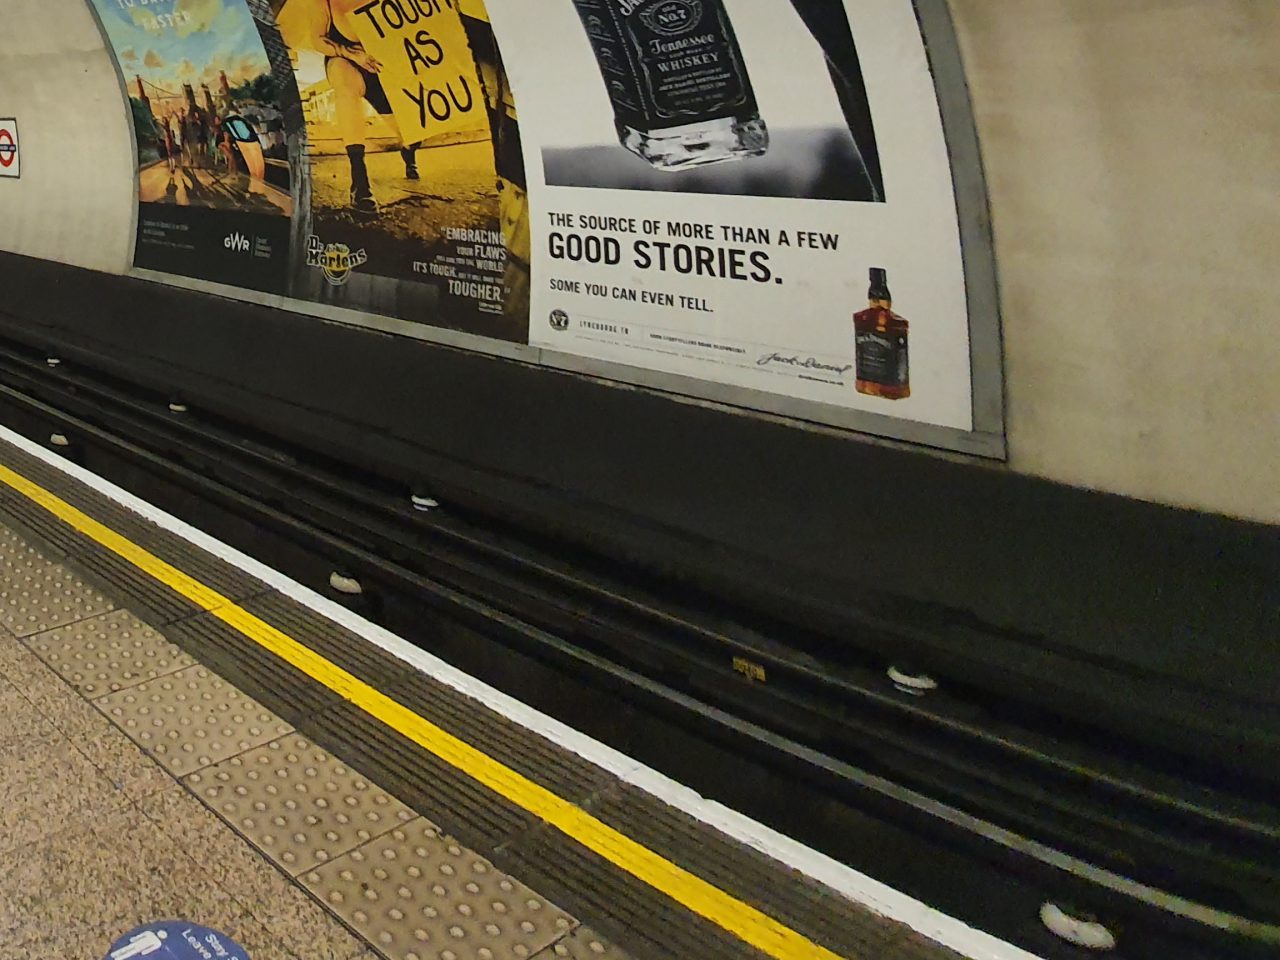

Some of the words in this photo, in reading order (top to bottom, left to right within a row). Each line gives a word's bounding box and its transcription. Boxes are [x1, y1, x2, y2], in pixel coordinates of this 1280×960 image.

[404, 30, 444, 75] AS
[649, 33, 715, 54] Tennessee
[657, 52, 719, 72] WHISKEY
[402, 75, 473, 129] YOU
[224, 231, 250, 252] GWR
[548, 212, 575, 228] THE
[579, 214, 637, 233] SOURCE
[642, 220, 661, 235] OF
[667, 221, 715, 240] MORE
[720, 225, 770, 245] THAN
[778, 230, 791, 247] A
[797, 231, 839, 250] FEW
[307, 248, 368, 268] Martens
[474, 245, 507, 260] FLAWS
[548, 232, 620, 265] GOOD
[633, 240, 783, 285] STORIES.
[549, 278, 581, 294] SOME
[584, 282, 608, 297] YOU
[612, 287, 637, 301] CAN
[641, 291, 674, 307] EVEN
[679, 295, 714, 313] TELL.
[181, 928, 212, 960] Leave
[205, 933, 229, 957] Stay
